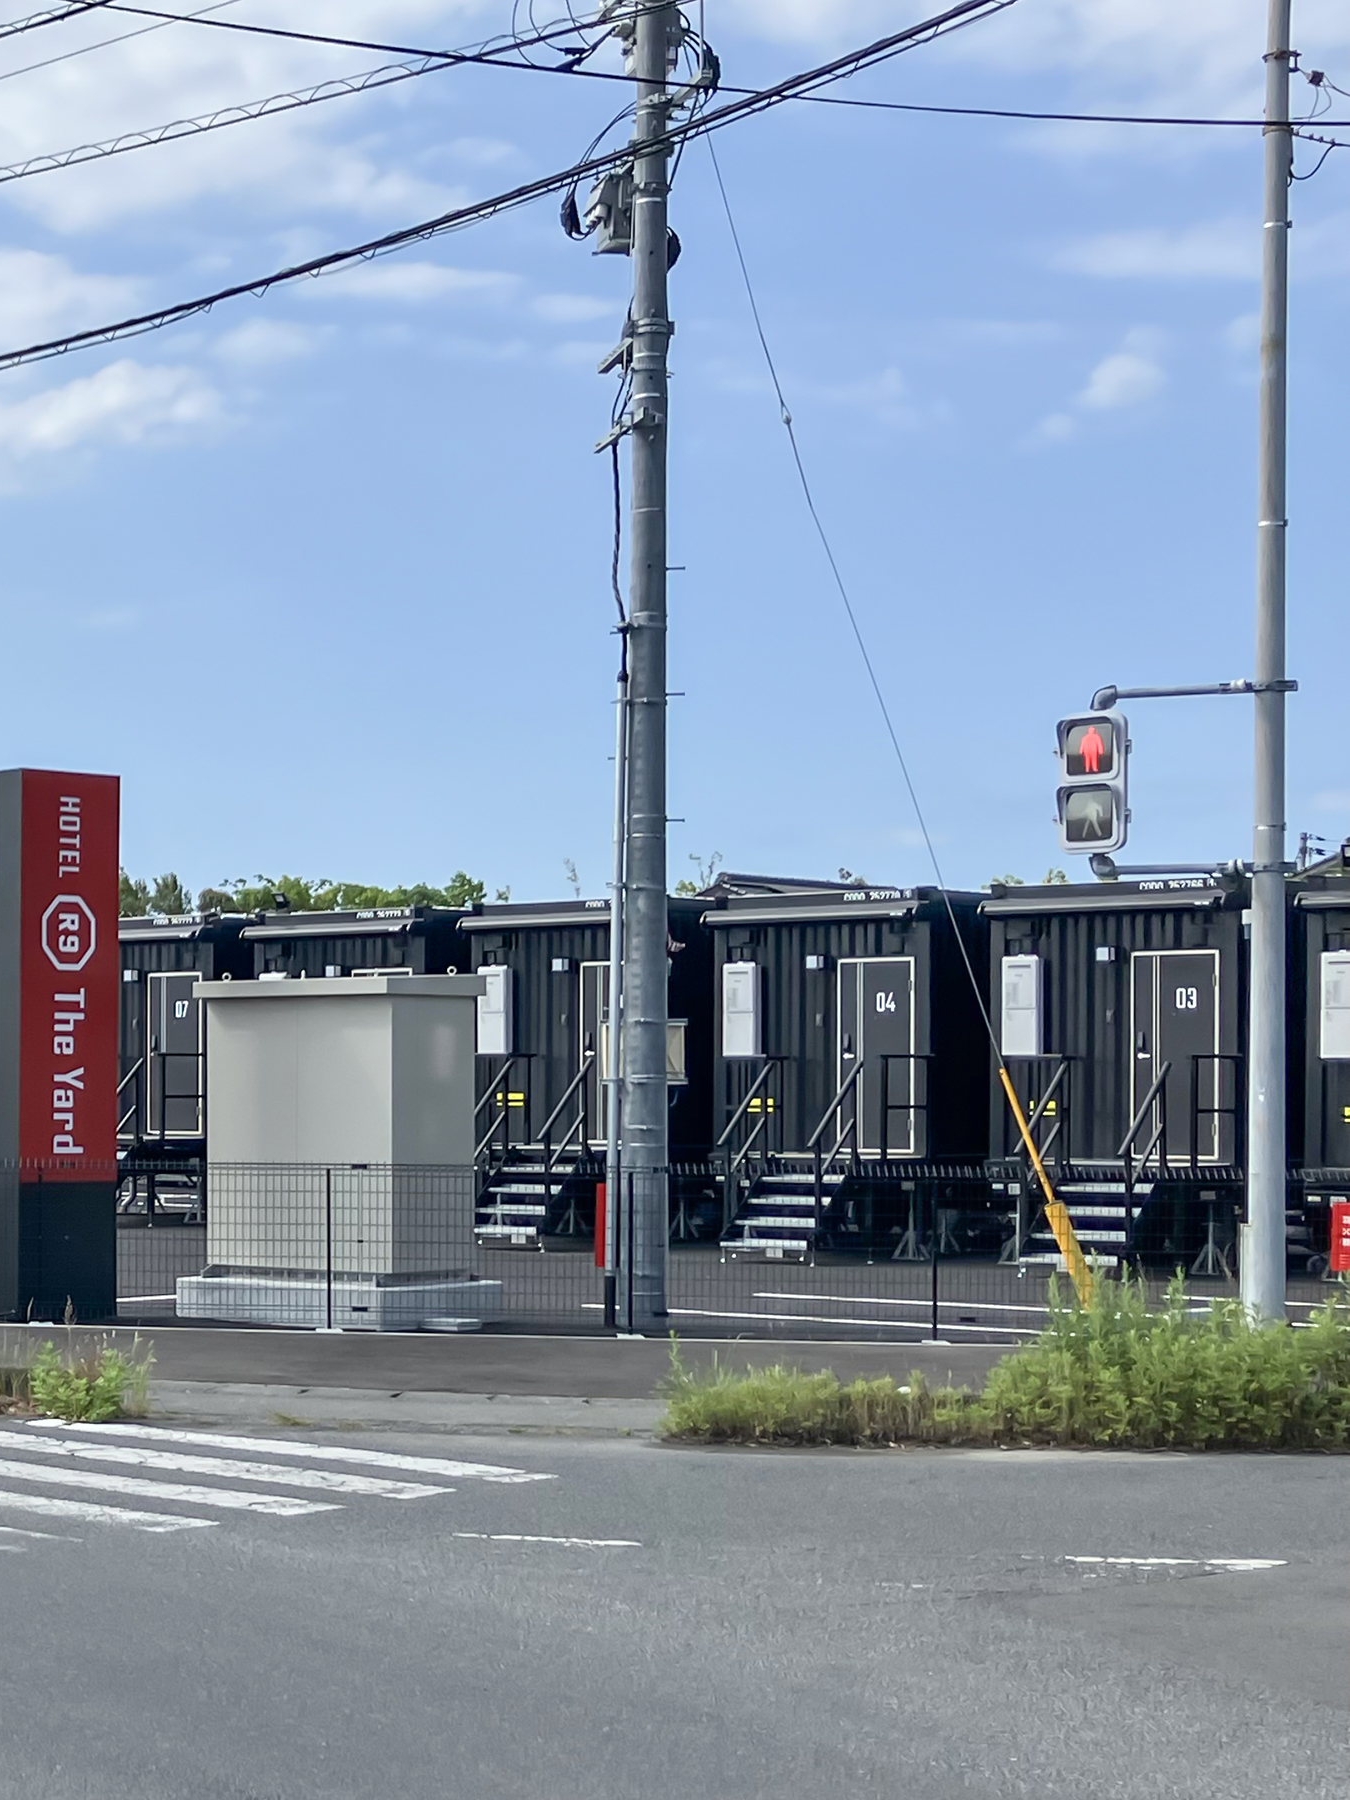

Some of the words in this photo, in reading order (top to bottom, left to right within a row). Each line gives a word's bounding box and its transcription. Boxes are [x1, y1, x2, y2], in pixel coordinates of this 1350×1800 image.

[58, 795, 81, 878] HOTEL
[58, 912, 80, 953] R9
[175, 1000, 189, 1018] 07
[876, 991, 896, 1013] 04
[1175, 987, 1198, 1009] 03
[53, 987, 86, 1055] The
[53, 1066, 85, 1154] Yard
